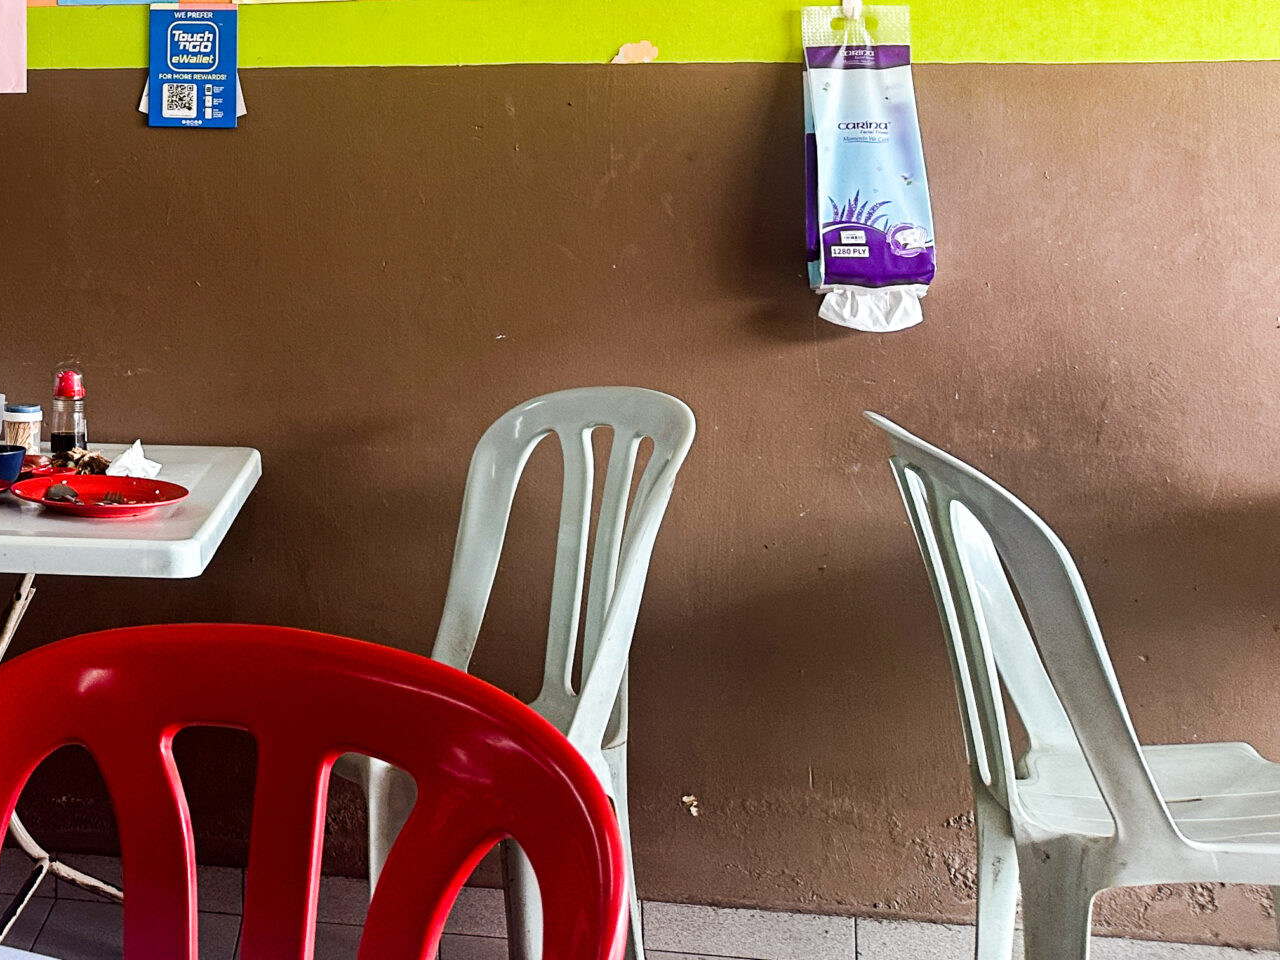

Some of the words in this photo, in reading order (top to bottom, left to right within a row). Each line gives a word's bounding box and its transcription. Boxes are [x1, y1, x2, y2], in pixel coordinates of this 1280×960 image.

[187, 11, 214, 19] PREFER
[171, 30, 214, 42] Touch
[171, 54, 215, 64] eWallet
[193, 73, 227, 81] REWARDS!
